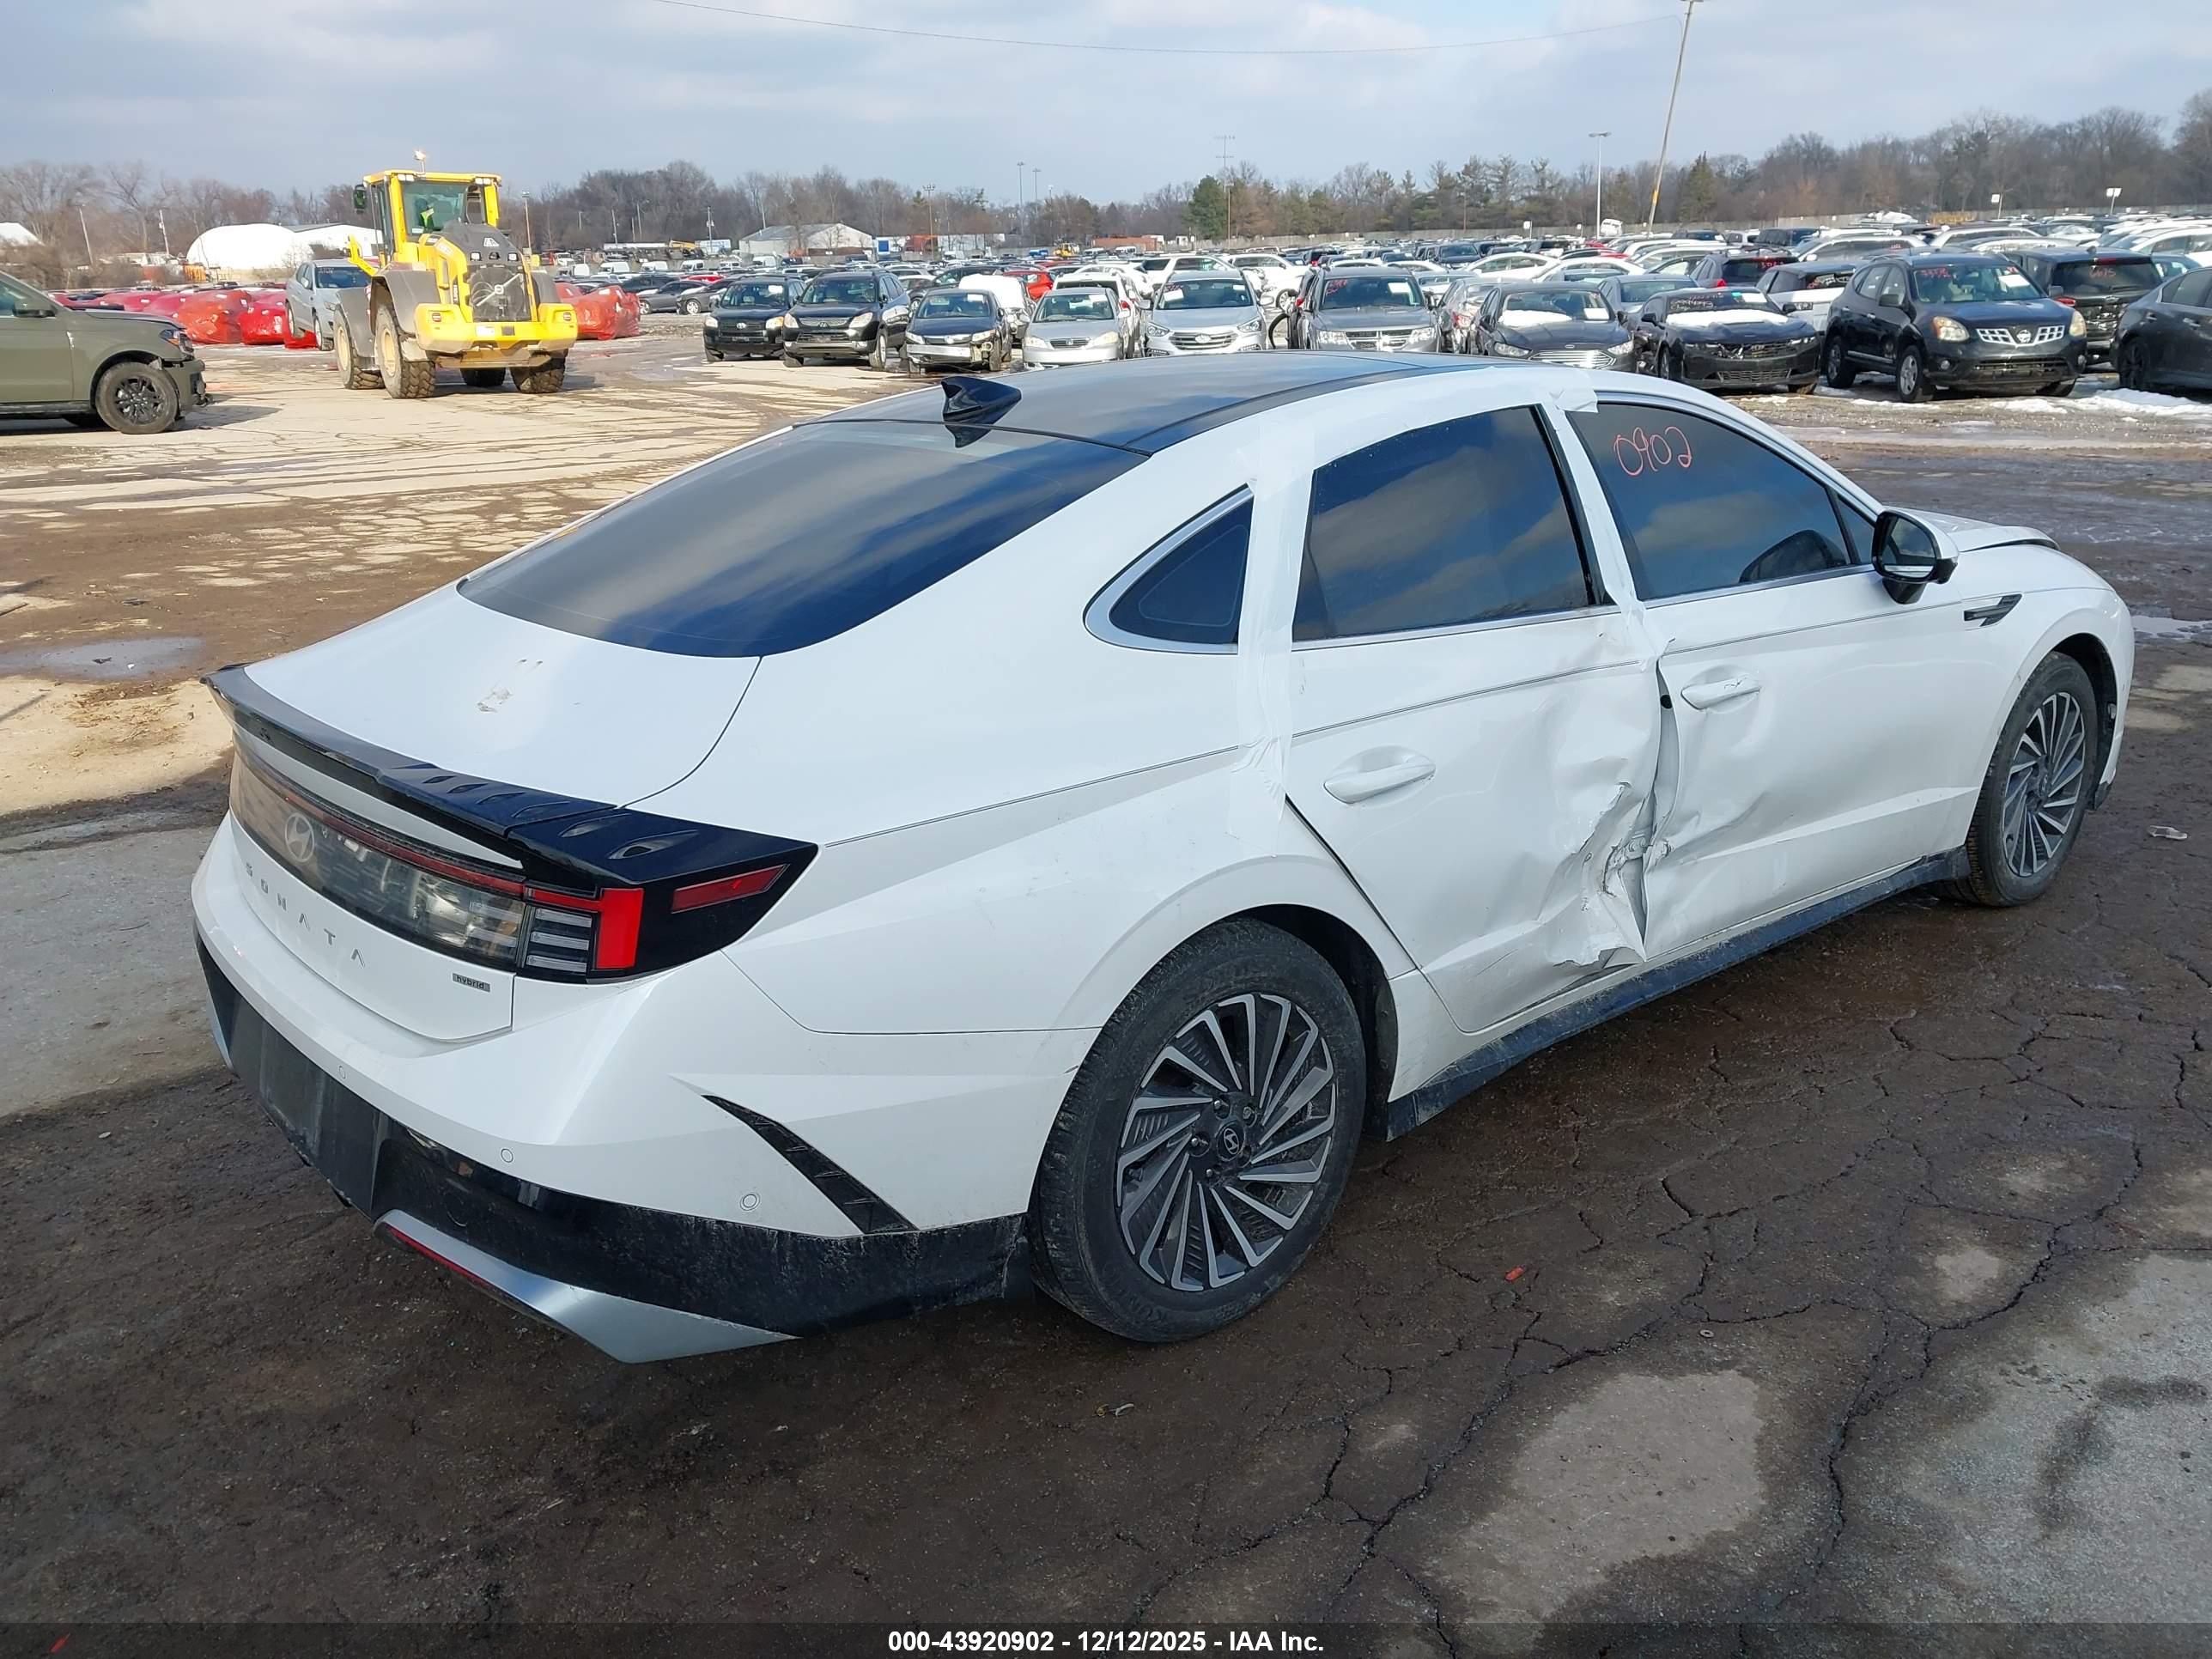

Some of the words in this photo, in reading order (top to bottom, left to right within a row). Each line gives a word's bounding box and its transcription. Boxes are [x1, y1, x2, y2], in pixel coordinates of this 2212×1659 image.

[1613, 426, 1692, 476] 0902
[246, 862, 365, 968] SONATA
[455, 974, 487, 990] hybrid
